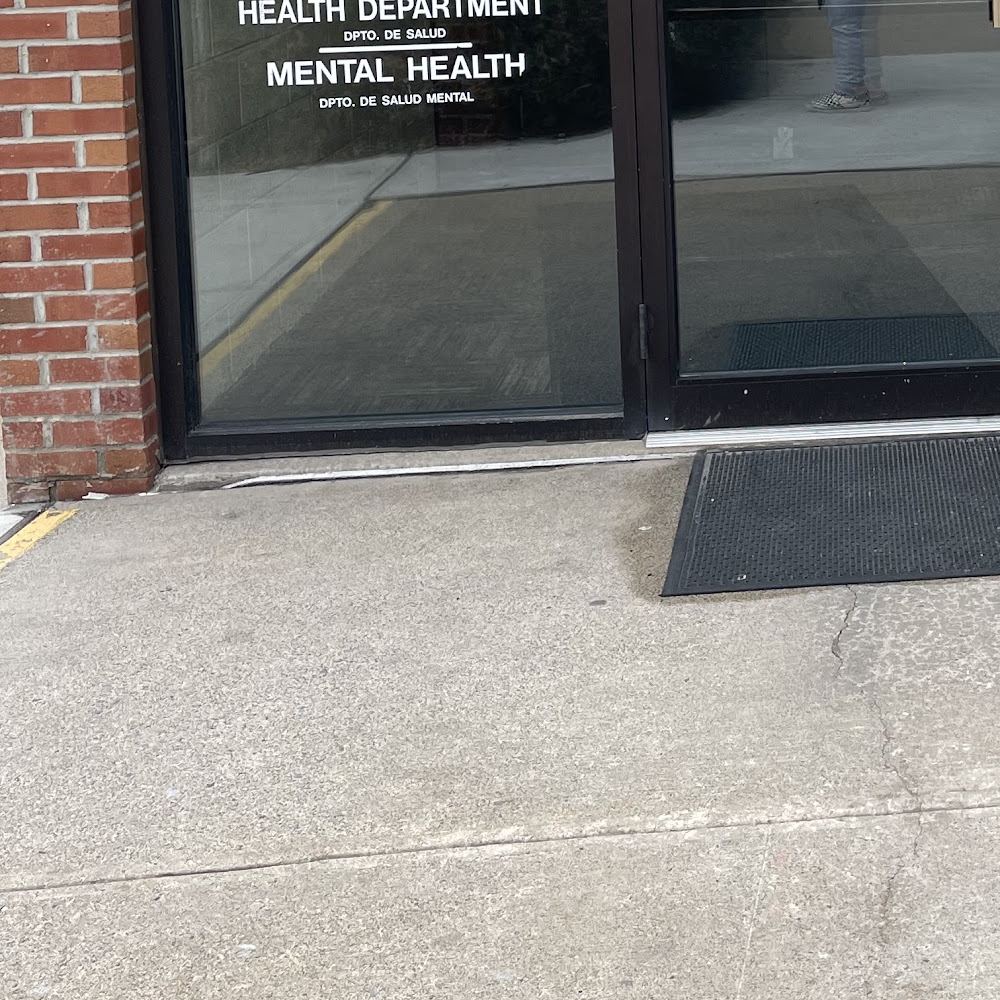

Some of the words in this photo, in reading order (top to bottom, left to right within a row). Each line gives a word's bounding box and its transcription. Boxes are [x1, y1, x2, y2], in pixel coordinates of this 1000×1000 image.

[344, 29, 380, 41] DPTO.
[384, 29, 401, 40] DE
[405, 27, 446, 40] SALUD
[266, 58, 393, 87] MENTAL
[407, 53, 525, 81] HEALTH
[319, 96, 356, 109] DPTO.
[360, 95, 377, 107] DE
[381, 94, 422, 106] SALUD
[426, 92, 474, 104] MENTAL
